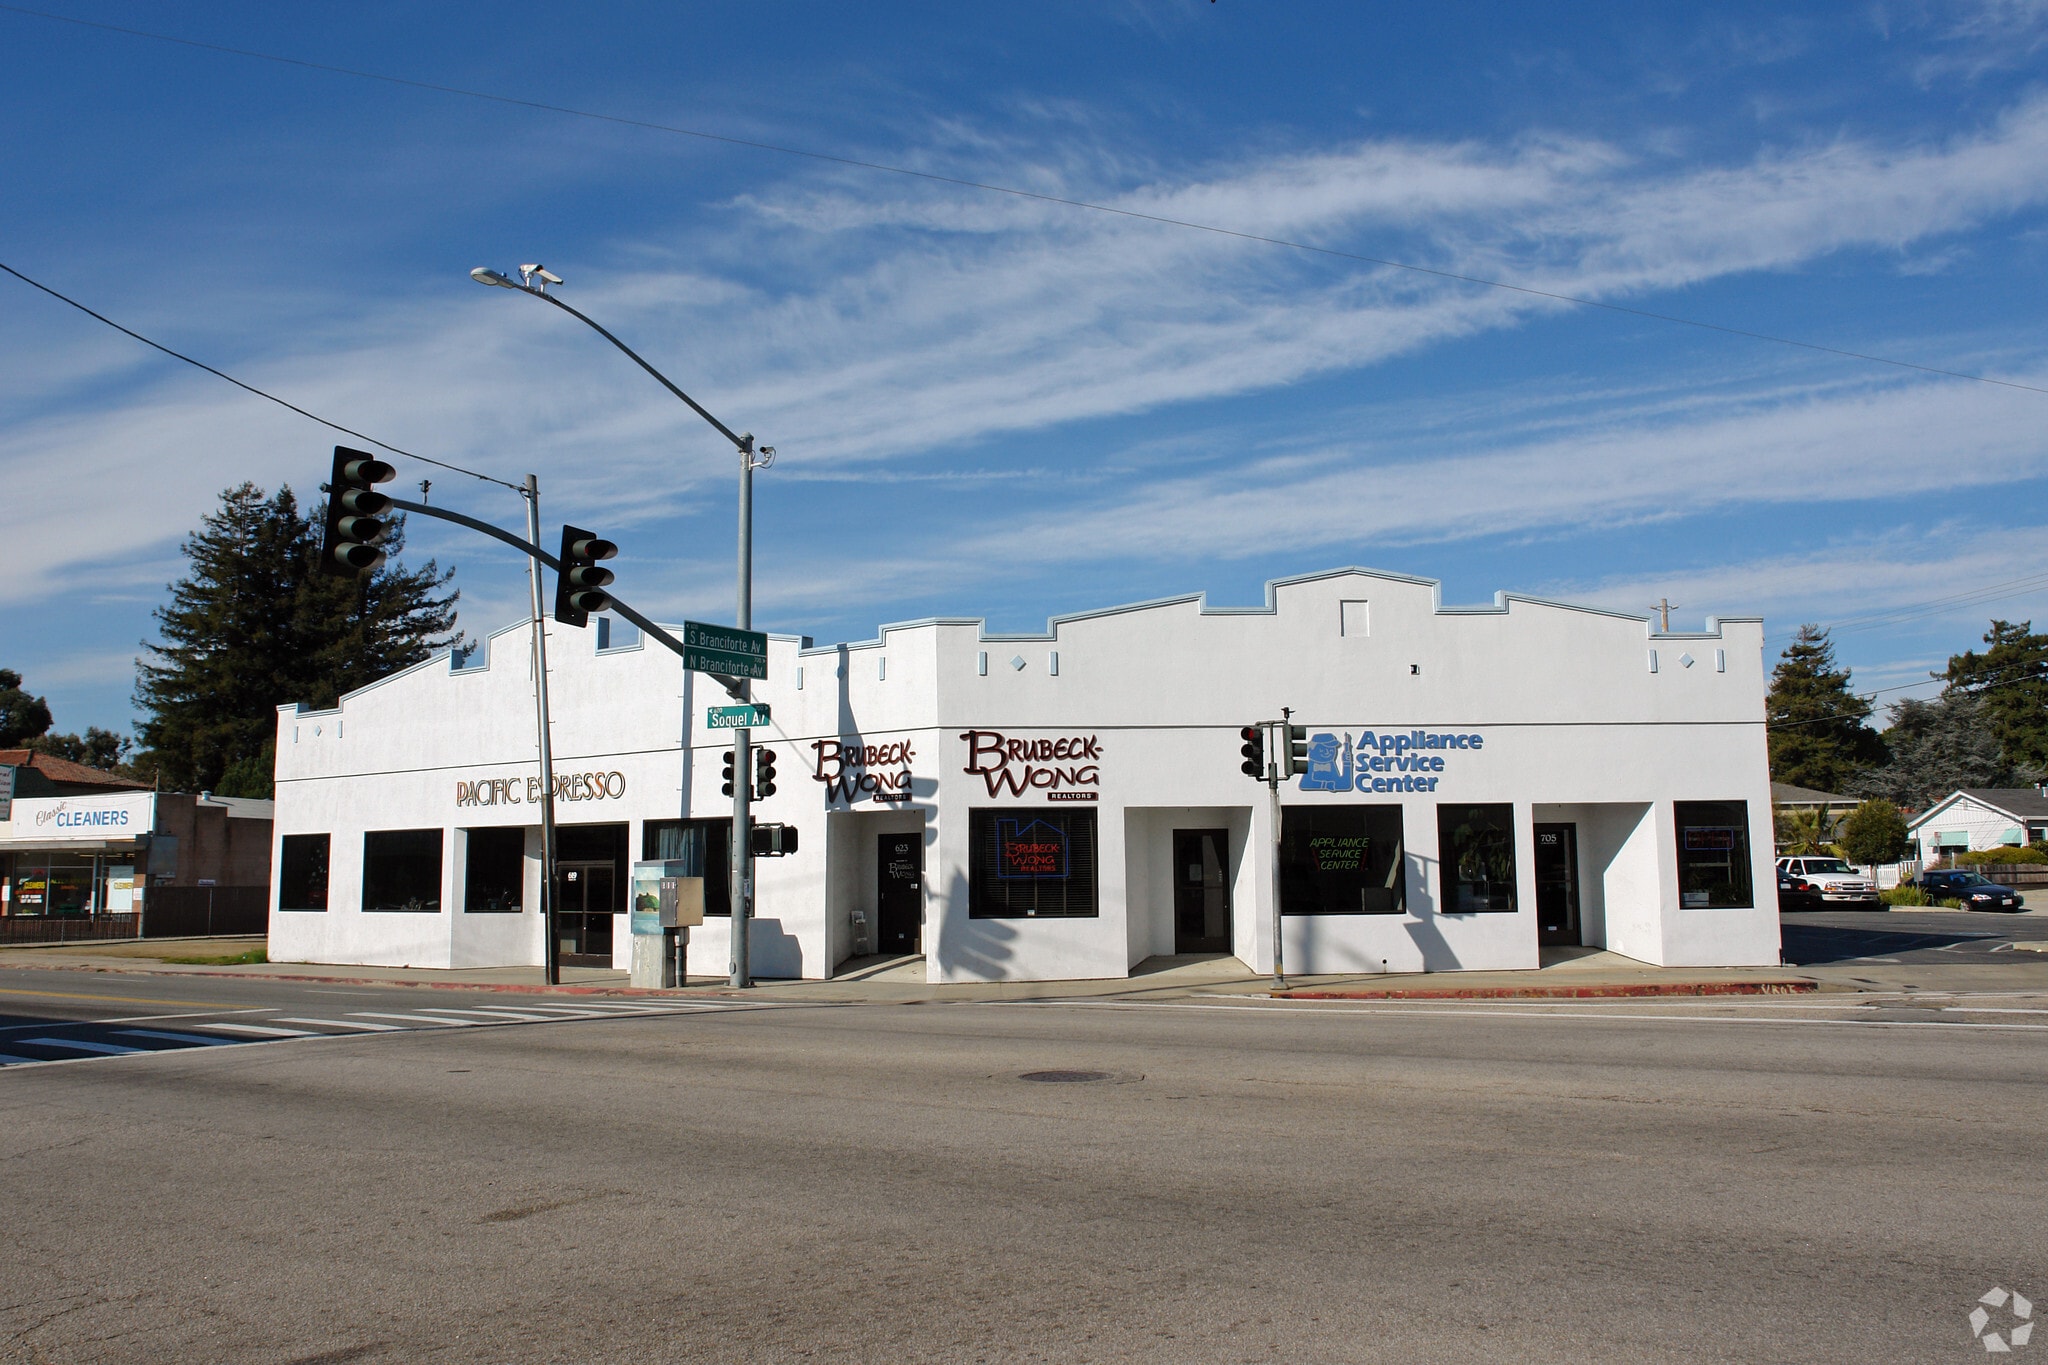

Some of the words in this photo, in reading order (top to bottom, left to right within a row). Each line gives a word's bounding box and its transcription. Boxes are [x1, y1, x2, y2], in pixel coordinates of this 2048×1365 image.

[690, 630, 696, 645] S
[699, 631, 748, 652] Branciforte
[750, 640, 761, 654] Av
[689, 654, 697, 669] N
[700, 656, 749, 676] Branciforte
[752, 663, 763, 677] Av
[711, 712, 748, 729] Soquel
[1356, 730, 1484, 757] Appliance
[1355, 752, 1445, 773] Service
[823, 769, 913, 804] WONG
[979, 764, 1100, 799] WONG
[1354, 773, 1439, 793] Center
[456, 777, 521, 807] PACIFIC
[875, 793, 906, 801] REALTORS
[1051, 792, 1092, 800] REALTORS
[35, 800, 67, 827] Classic
[56, 810, 129, 828] CLEANERS
[894, 843, 909, 852] 623
[1309, 837, 1370, 848] APPLIANCE
[1319, 849, 1362, 859] SERVICE
[1320, 860, 1359, 870] CENTER
